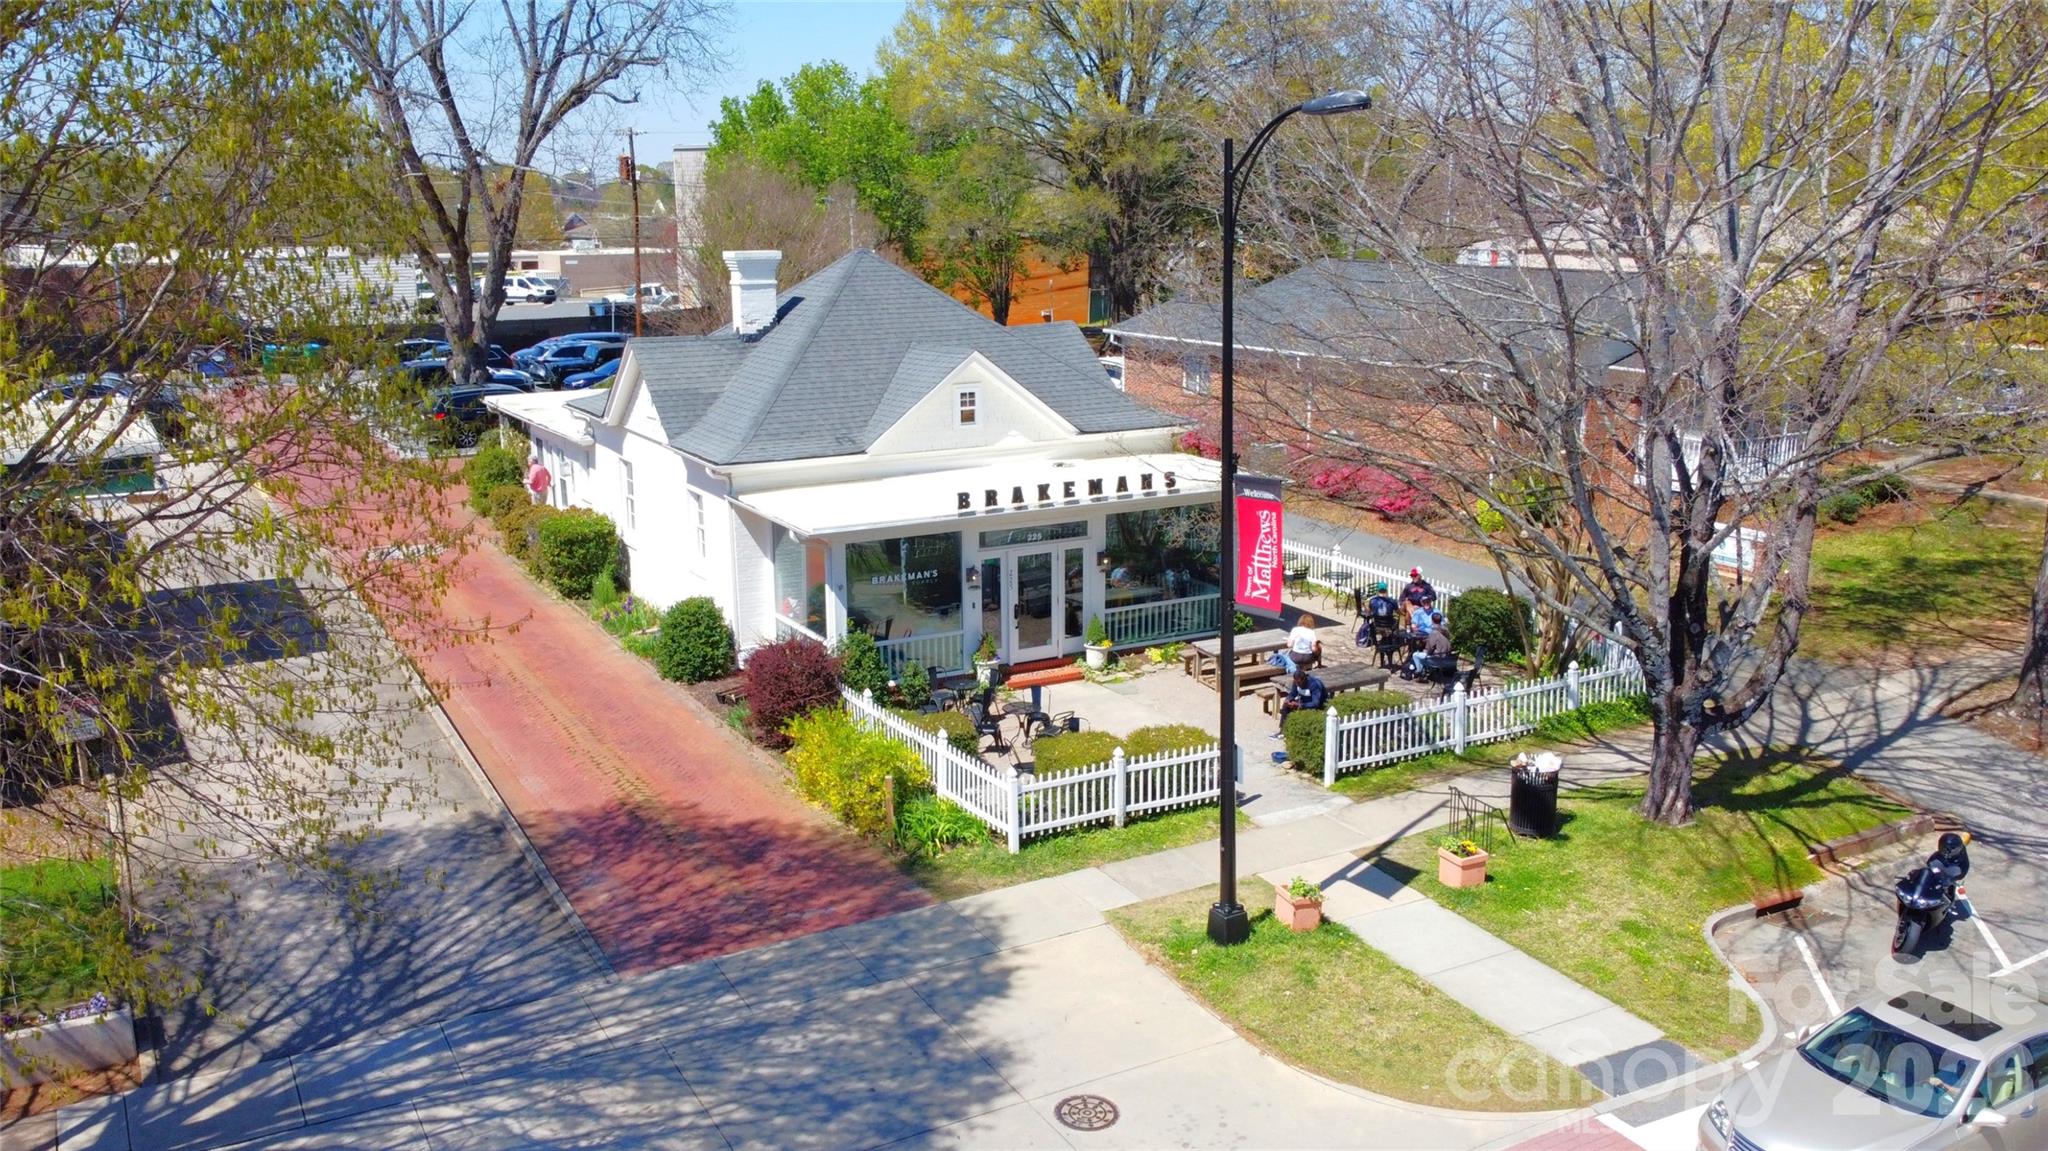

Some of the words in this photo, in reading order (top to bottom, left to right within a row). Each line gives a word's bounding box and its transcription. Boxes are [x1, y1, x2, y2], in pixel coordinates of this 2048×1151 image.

[957, 471, 1177, 510] BRAKEMANS
[1243, 487, 1275, 501] Welcome
[1251, 509, 1272, 603] Matthews
[1271, 545, 1279, 569] North
[871, 569, 938, 585] BRAKEMAN'S
[1244, 574, 1253, 598] Town
